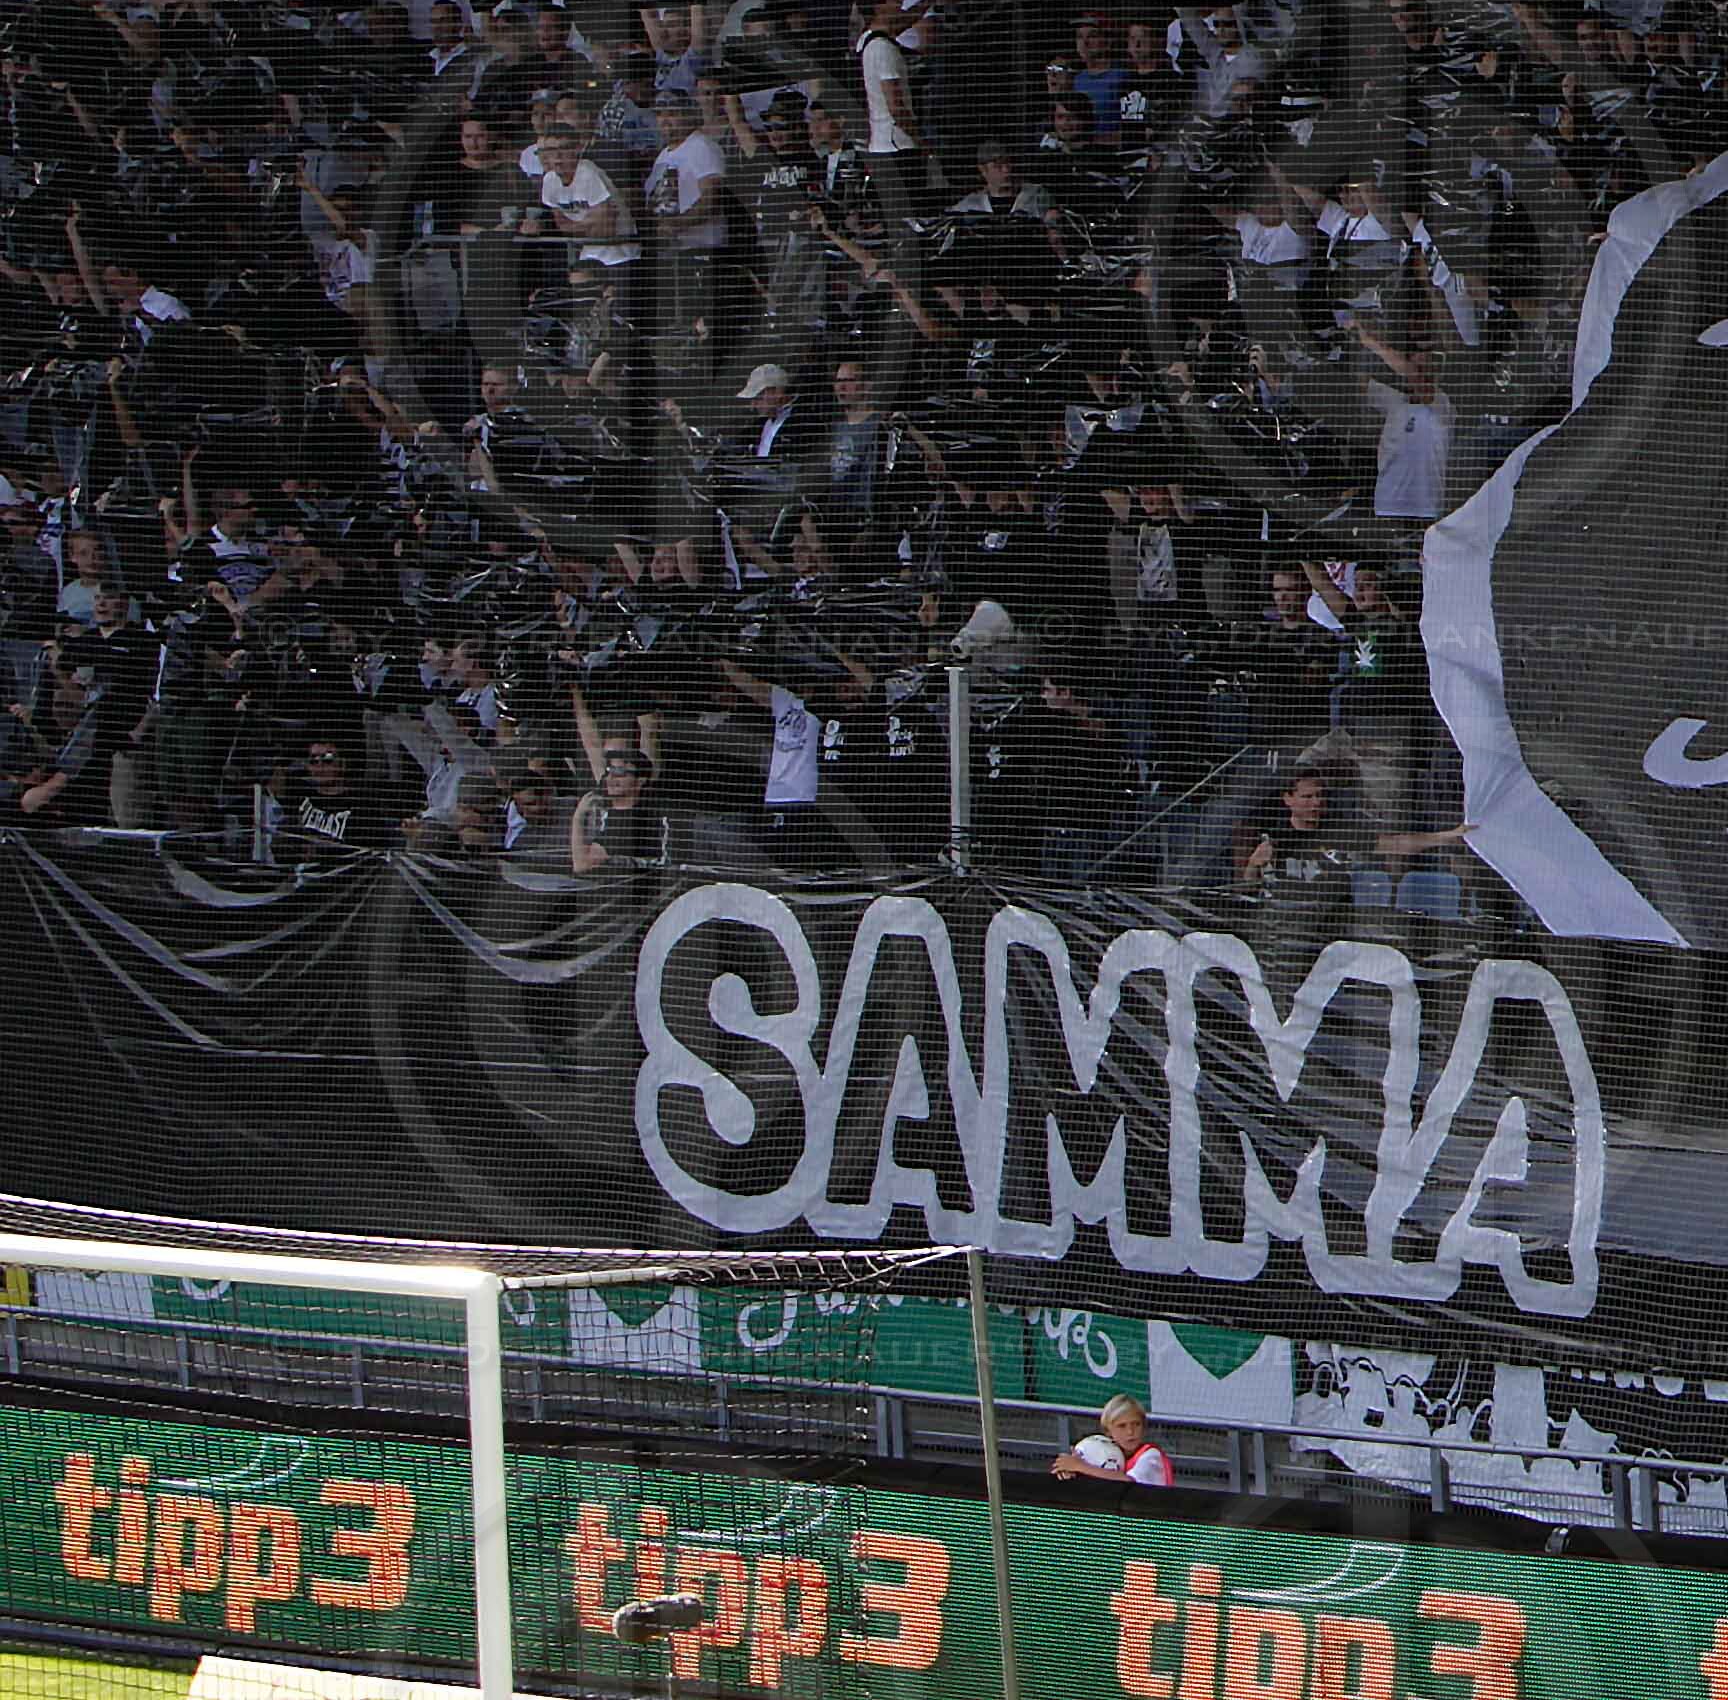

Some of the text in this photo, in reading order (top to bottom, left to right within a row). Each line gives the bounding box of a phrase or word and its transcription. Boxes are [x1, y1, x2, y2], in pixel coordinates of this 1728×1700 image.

[635, 883, 1605, 1318] SAMMA
[53, 1451, 417, 1635] tipp3
[564, 1502, 953, 1692] tipp3
